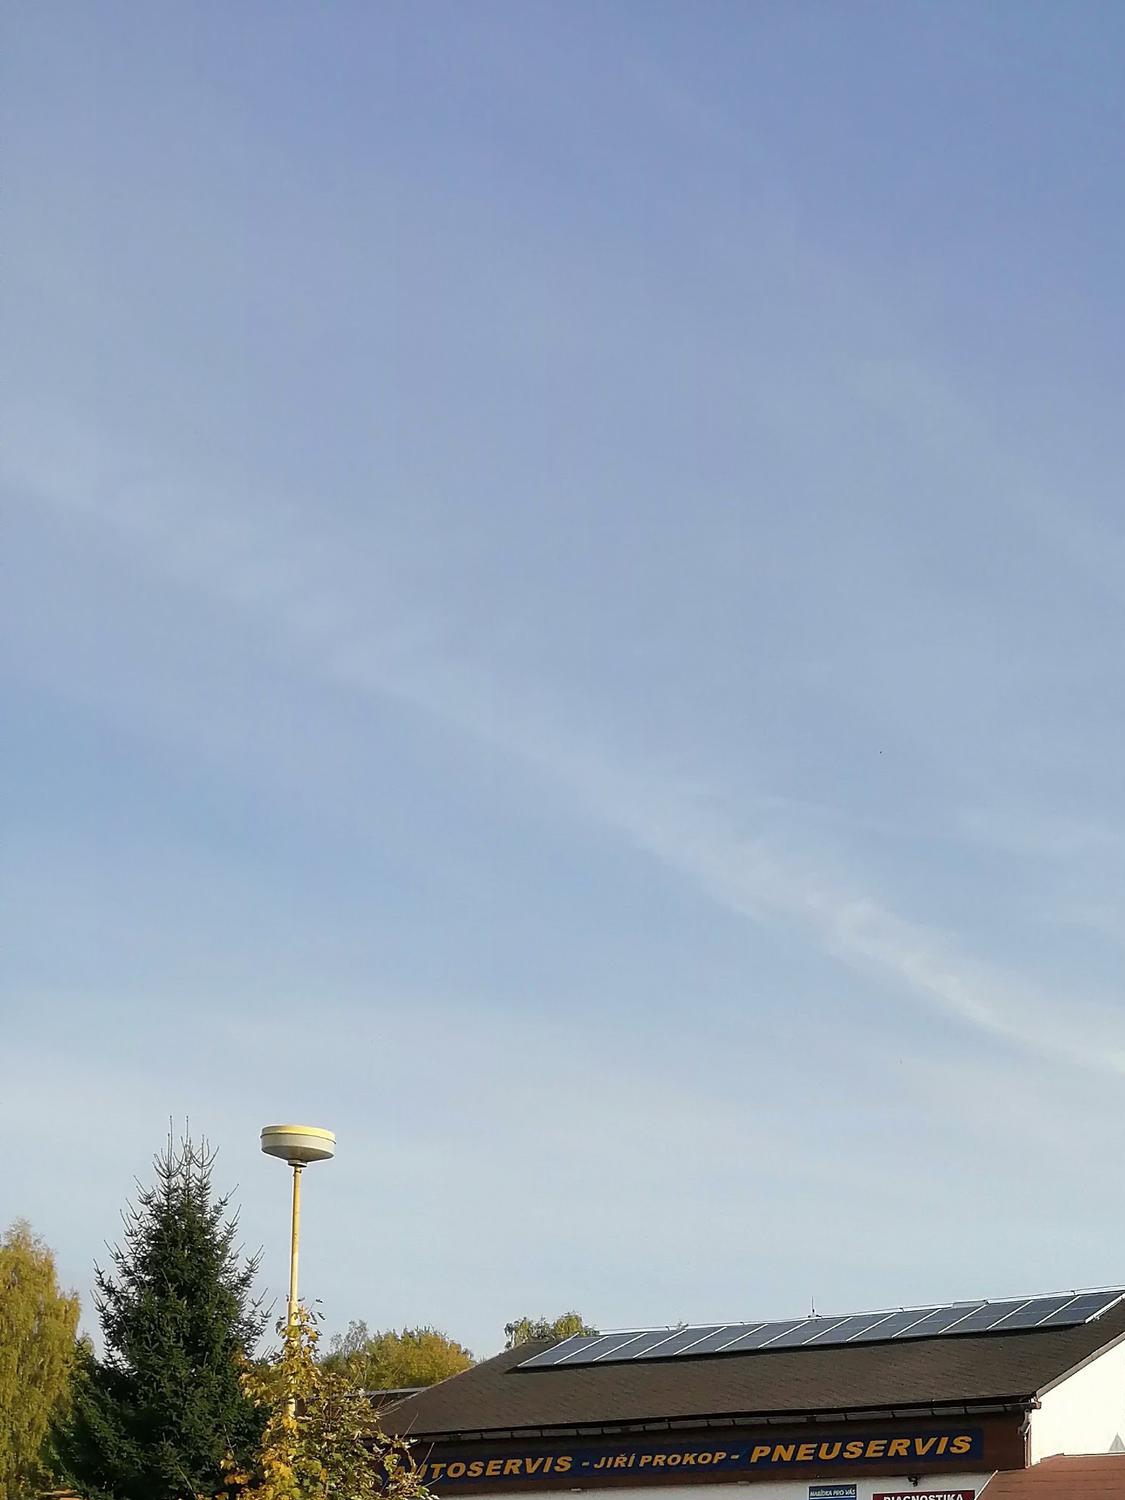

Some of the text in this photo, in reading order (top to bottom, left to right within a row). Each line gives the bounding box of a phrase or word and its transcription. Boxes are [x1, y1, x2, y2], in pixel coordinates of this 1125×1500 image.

[594, 1452, 635, 1469] JIŘÍ
[639, 1452, 726, 1468] PROKOP
[750, 1435, 973, 1463] PNEUSERVIS
